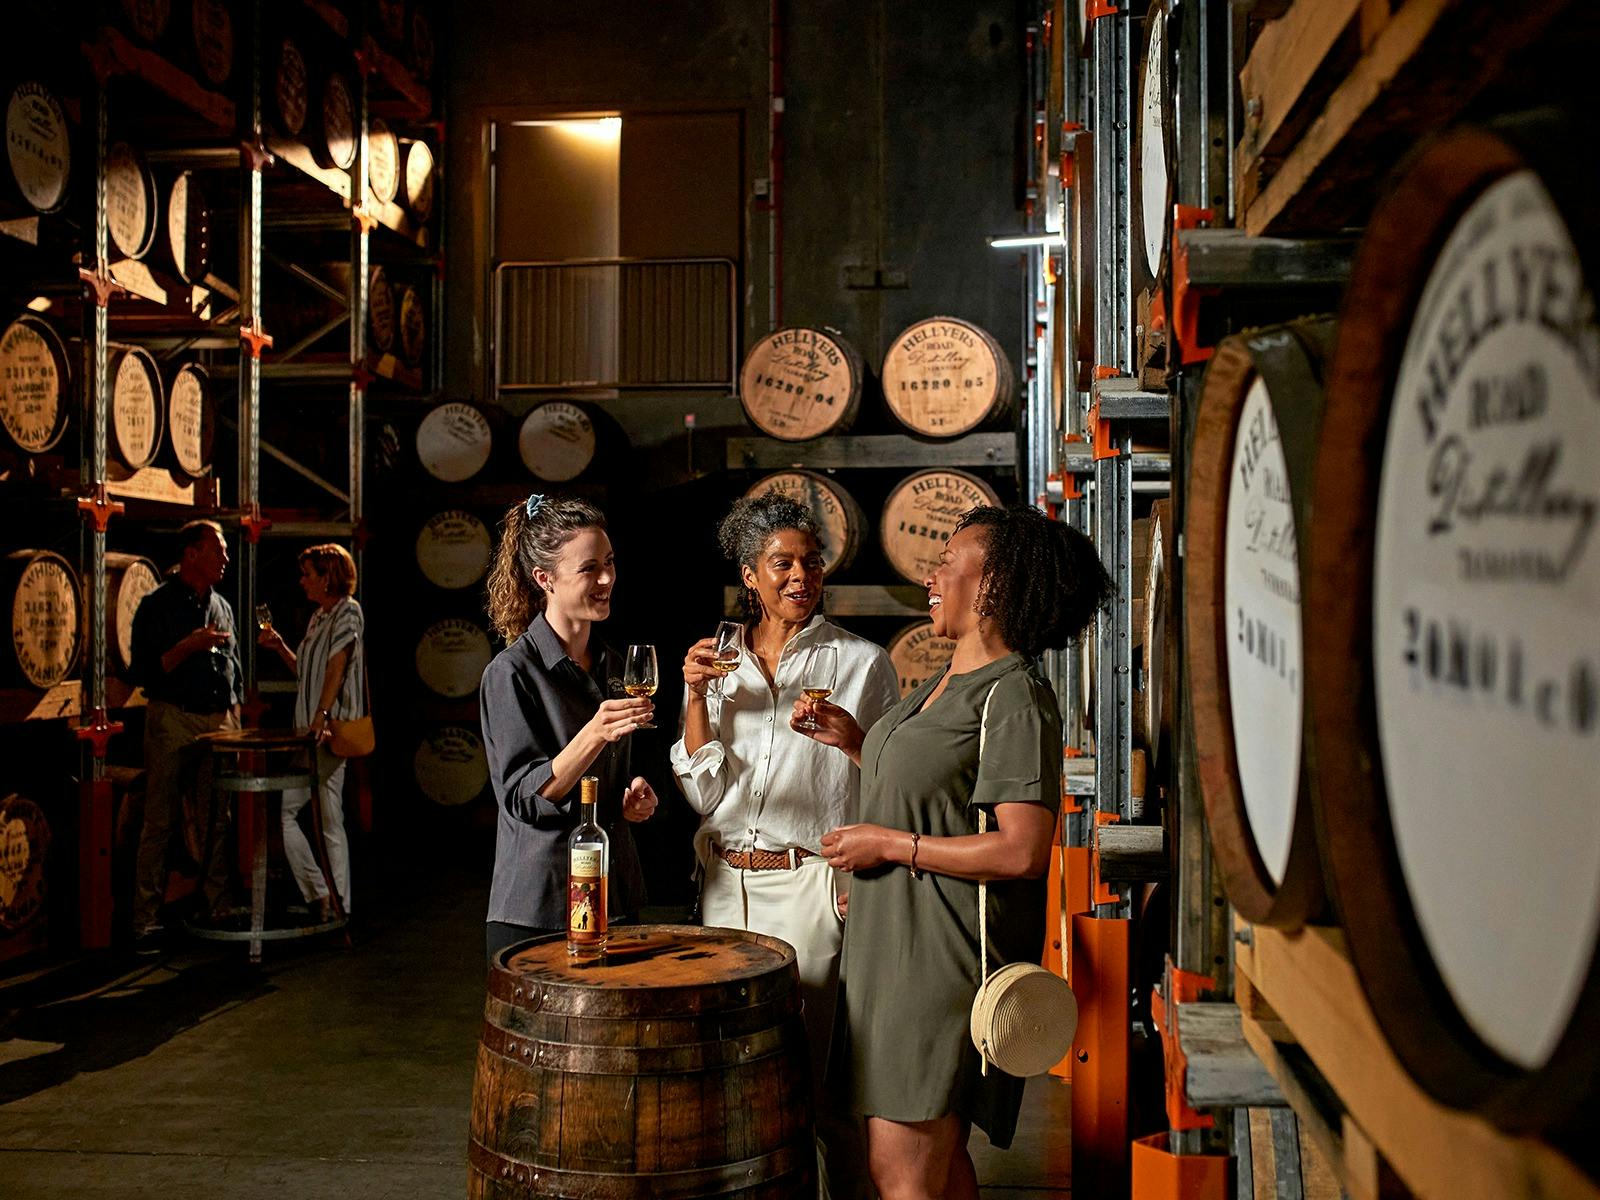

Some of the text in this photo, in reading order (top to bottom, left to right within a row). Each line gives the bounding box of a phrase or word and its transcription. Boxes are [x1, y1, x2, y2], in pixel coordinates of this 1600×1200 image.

[771, 332, 842, 366] HELLYERS
[903, 326, 977, 352] HELLYERS
[756, 374, 834, 406] 16280.04
[901, 377, 984, 391] 16280.05
[900, 521, 949, 542] 16280
